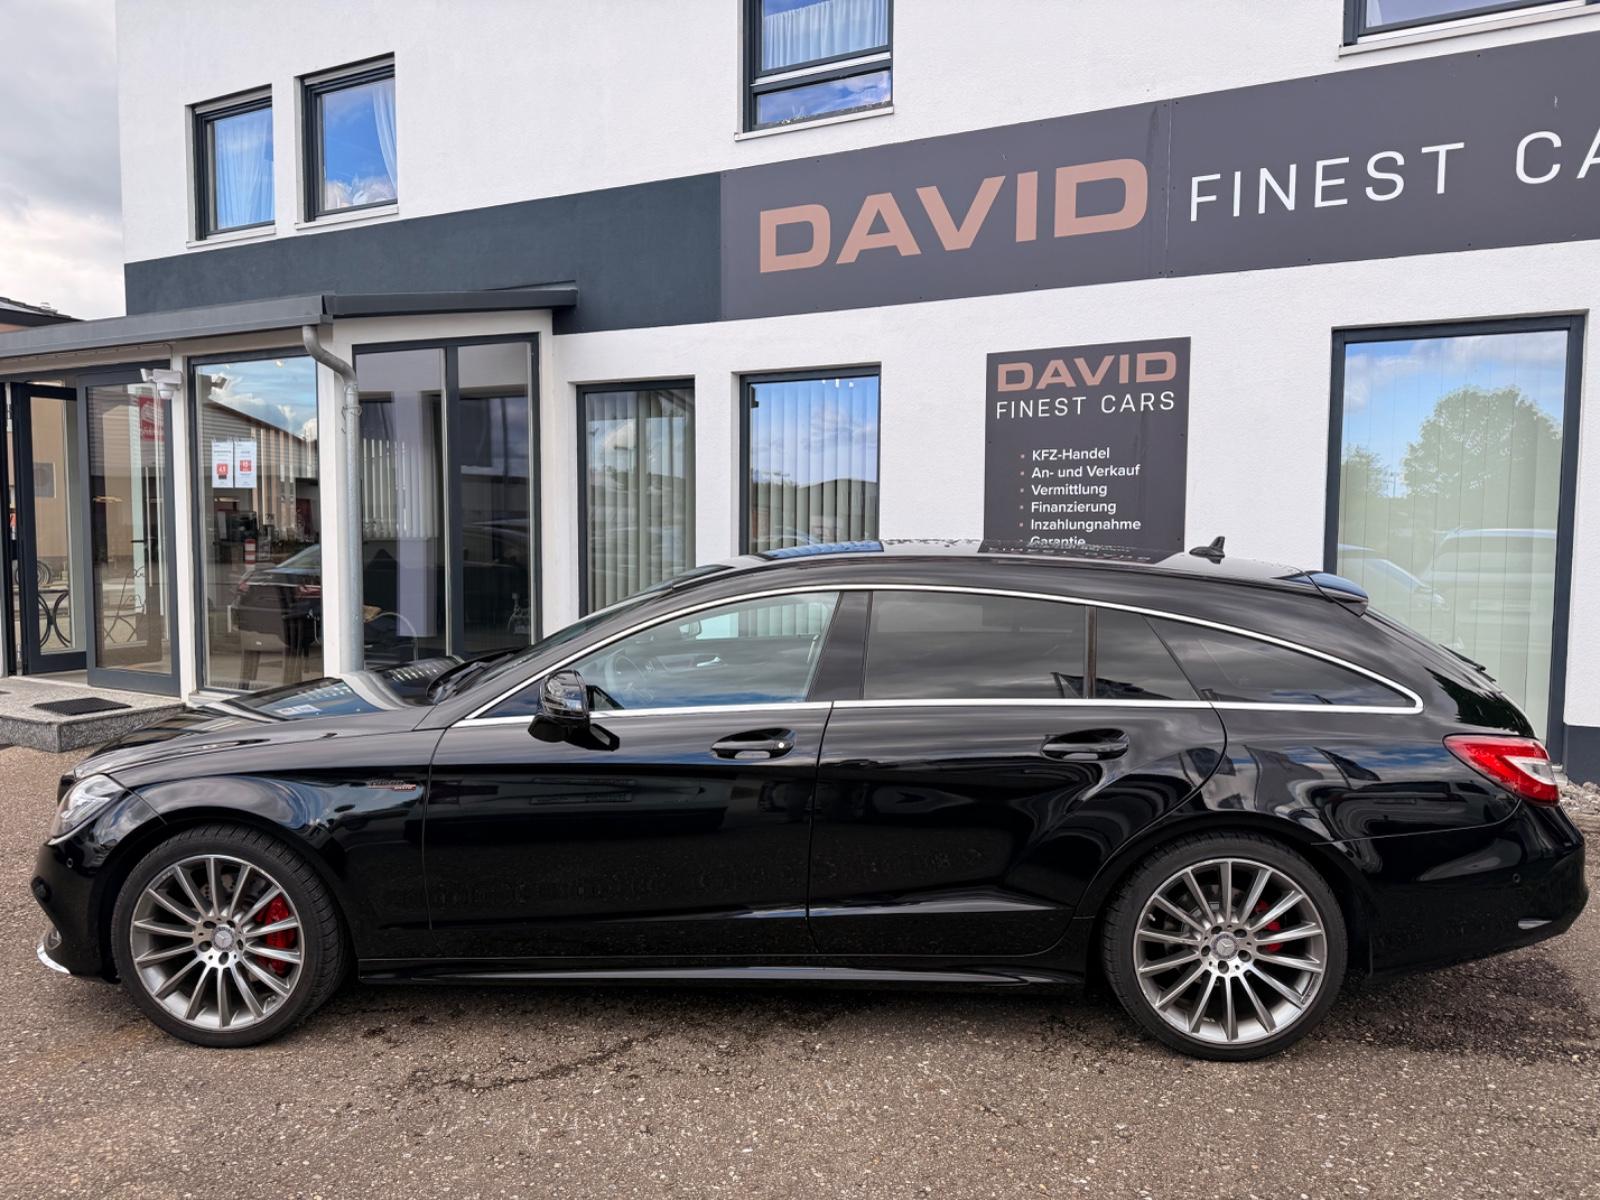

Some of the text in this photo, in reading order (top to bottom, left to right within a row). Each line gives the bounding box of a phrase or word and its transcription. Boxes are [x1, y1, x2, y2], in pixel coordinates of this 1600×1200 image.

[760, 159, 1149, 274] DAVID
[1190, 141, 1466, 222] FINEST
[997, 351, 1177, 392] DAVID
[995, 391, 1175, 420] FINEST CARS
[1032, 447, 1110, 462] KFZ-Handel
[1031, 464, 1141, 478] An- und Verkauf
[1031, 482, 1108, 497] Vermittlung
[1031, 501, 1117, 515] Finanzierung
[1030, 518, 1142, 533] Inzahlungnahme
